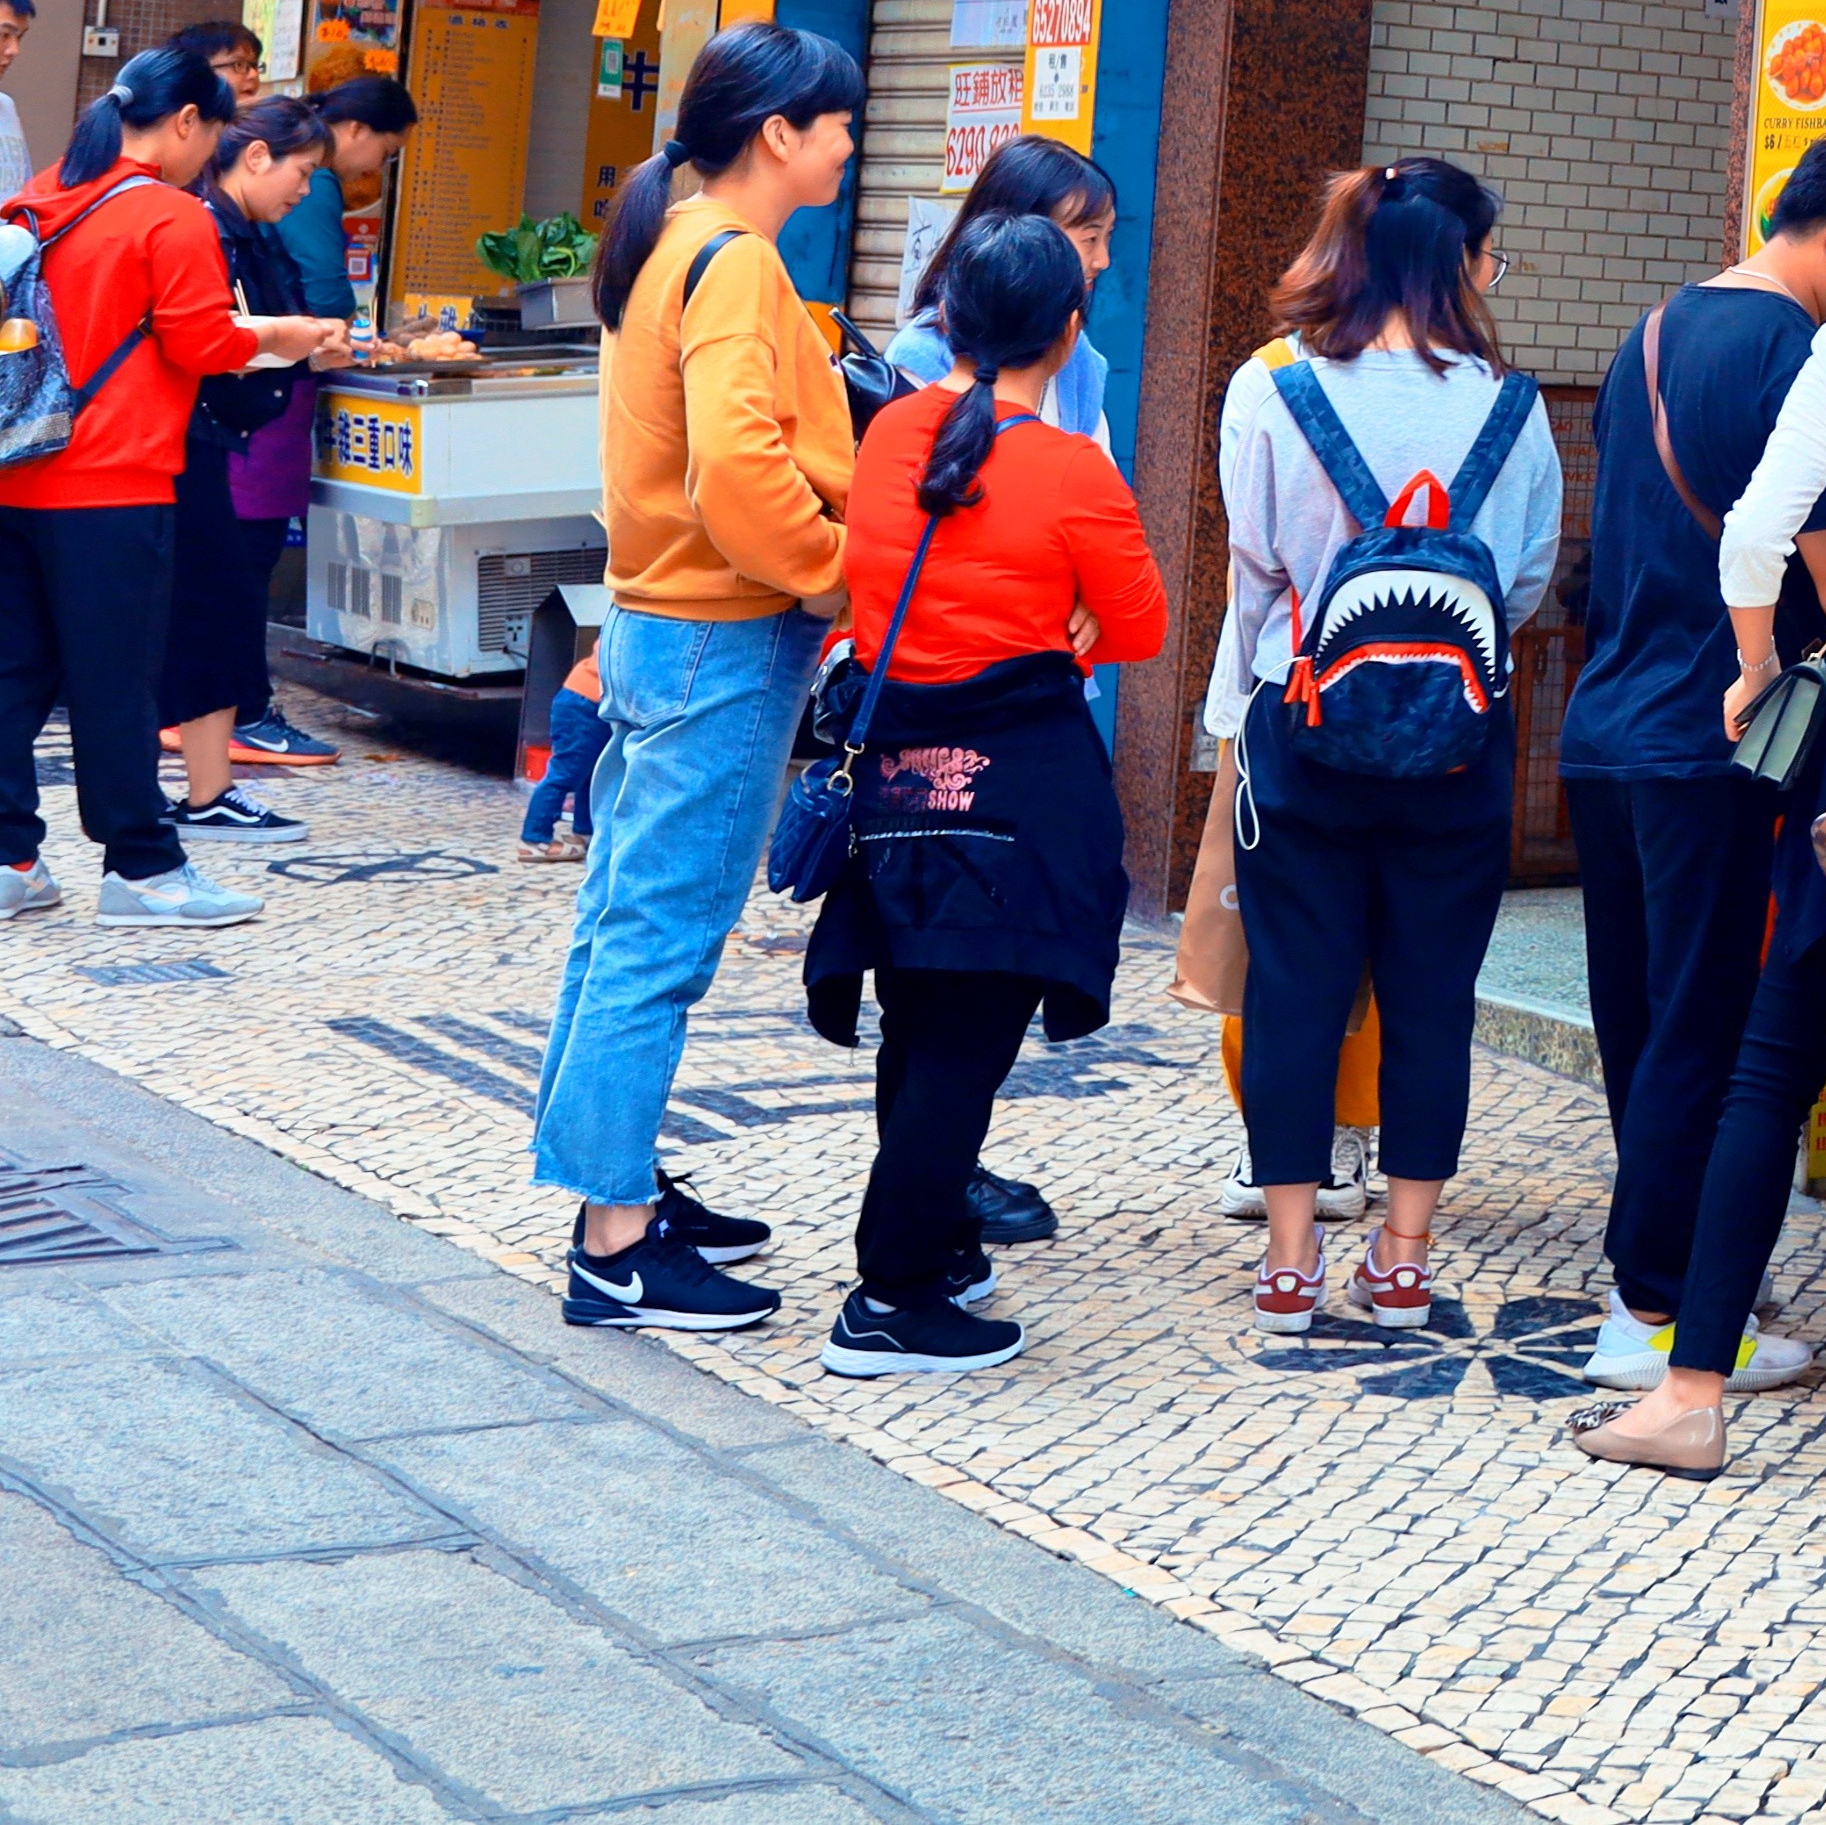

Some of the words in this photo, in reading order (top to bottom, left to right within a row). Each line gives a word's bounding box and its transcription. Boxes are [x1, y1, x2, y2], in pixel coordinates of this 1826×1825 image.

[1763, 117, 1792, 129] CURRY
[1764, 134, 1775, 150] $6
[947, 127, 982, 176] 6290
[928, 790, 975, 811] SHOW
